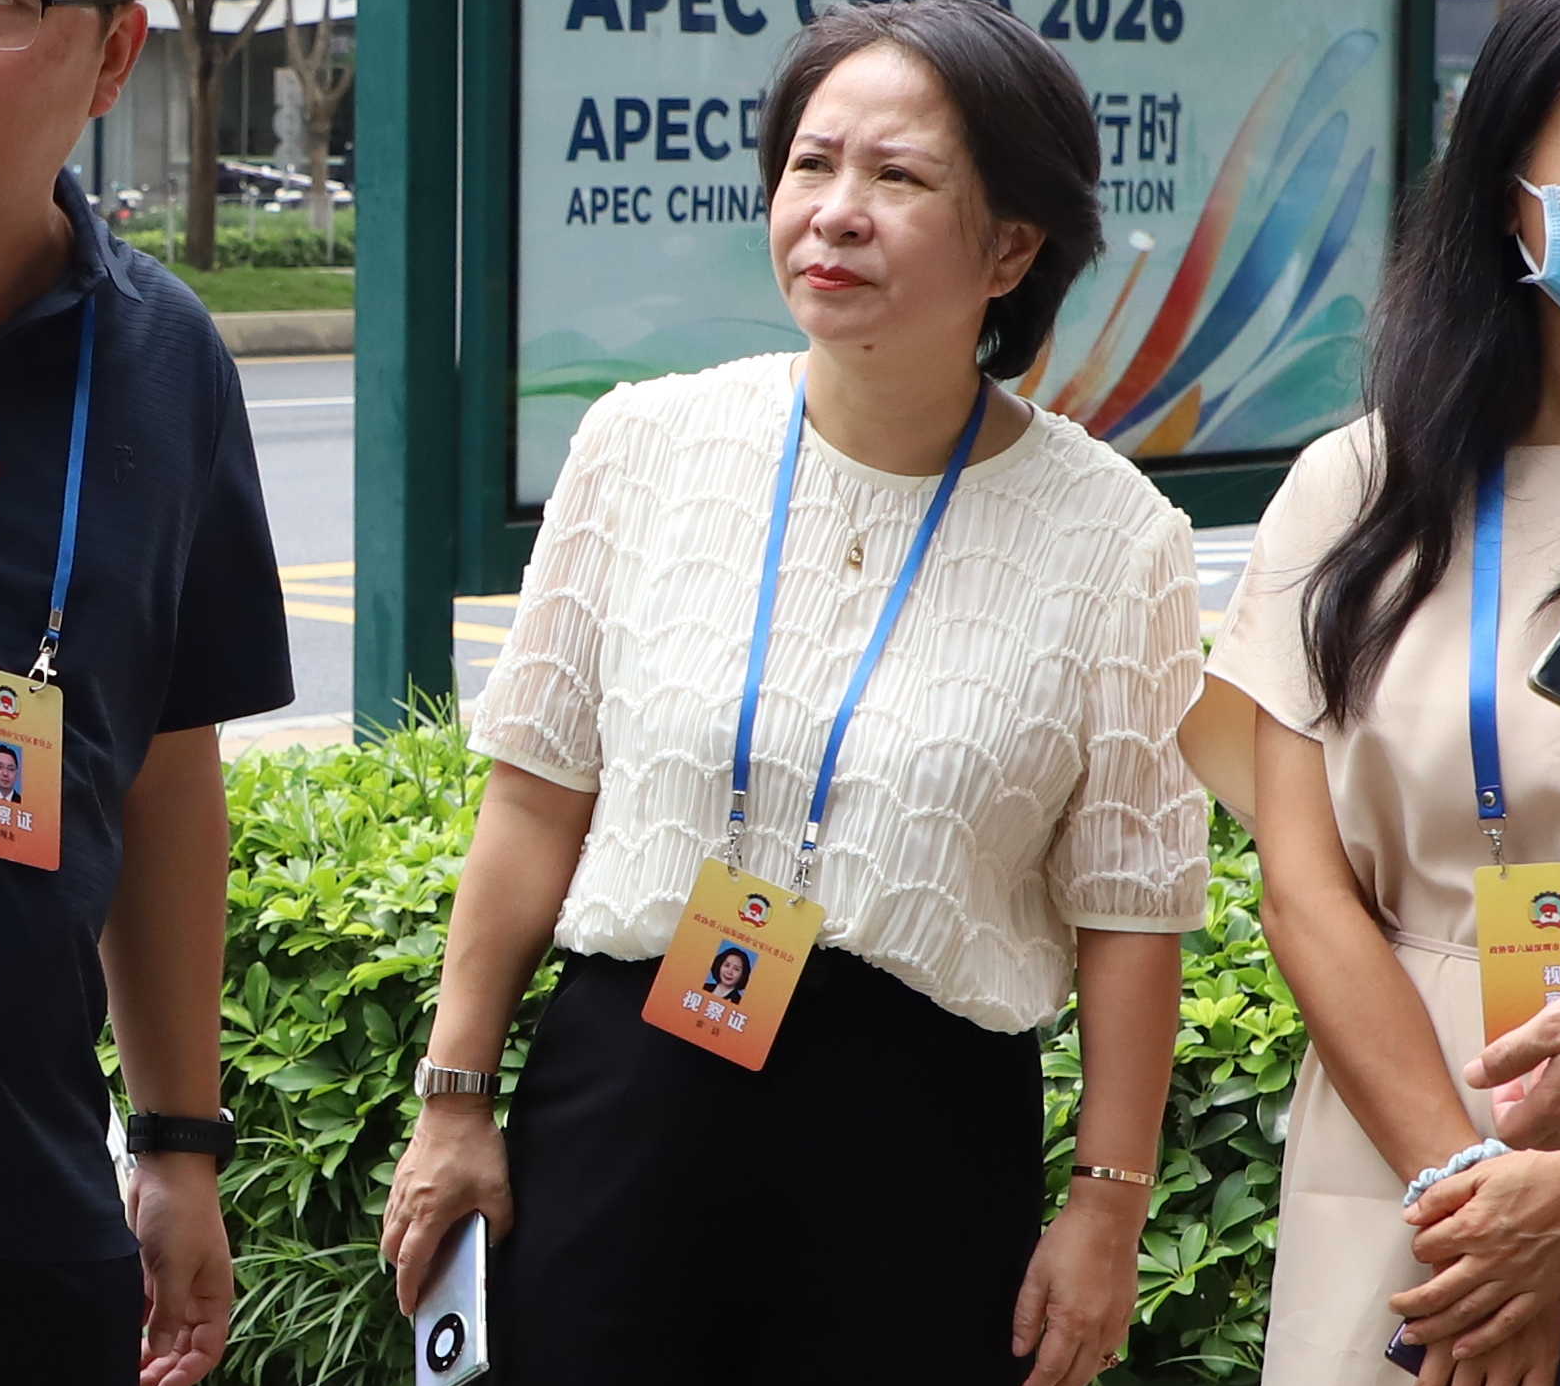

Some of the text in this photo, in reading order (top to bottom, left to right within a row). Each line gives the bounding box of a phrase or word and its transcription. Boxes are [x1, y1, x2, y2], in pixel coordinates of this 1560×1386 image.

[566, 185, 652, 226] APEC
[1099, 179, 1175, 214] TION
[682, 989, 749, 1033] 视察证
